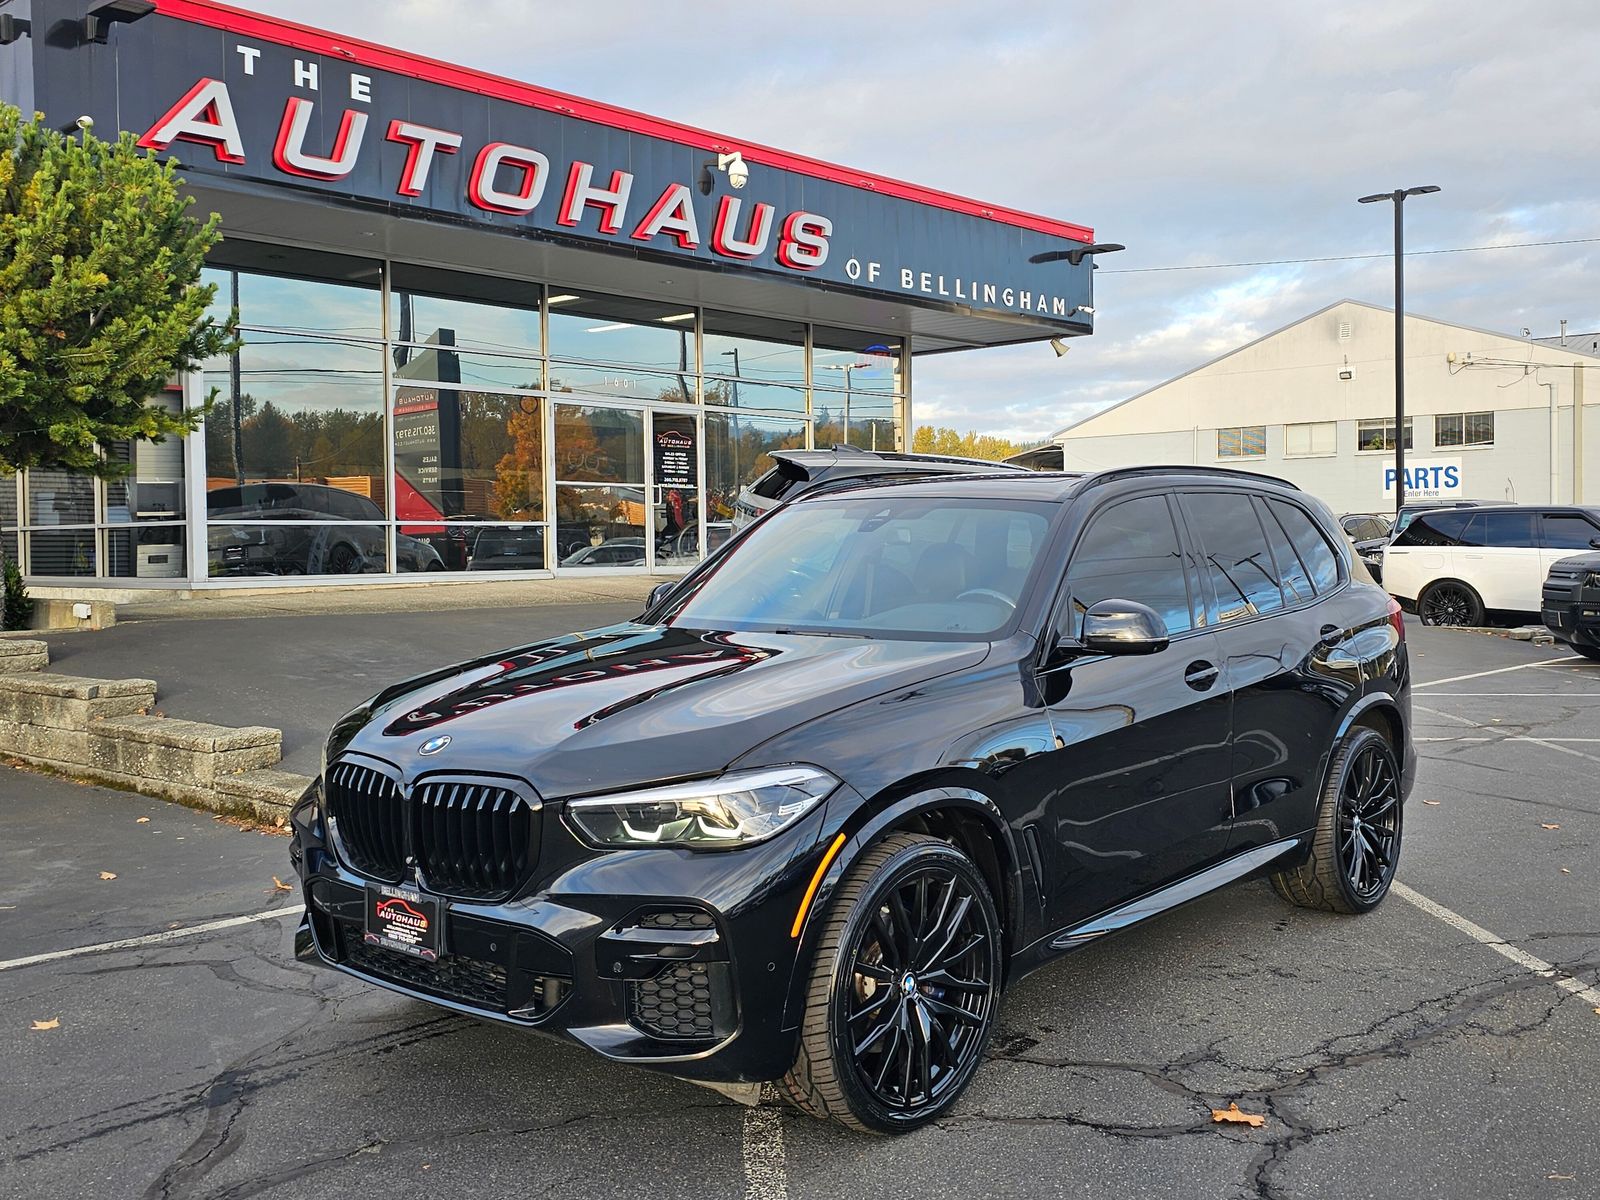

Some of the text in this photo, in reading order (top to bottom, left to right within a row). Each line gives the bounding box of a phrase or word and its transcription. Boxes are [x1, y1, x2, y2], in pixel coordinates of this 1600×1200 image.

[236, 45, 372, 103] THE
[138, 77, 833, 271] AUTOHAUS
[845, 258, 1066, 317] OF BELLINGHAM
[604, 376, 636, 390] 1601
[1385, 466, 1459, 490] PARTS
[1423, 489, 1440, 497] Here
[379, 910, 427, 928] AUTOHAUS
